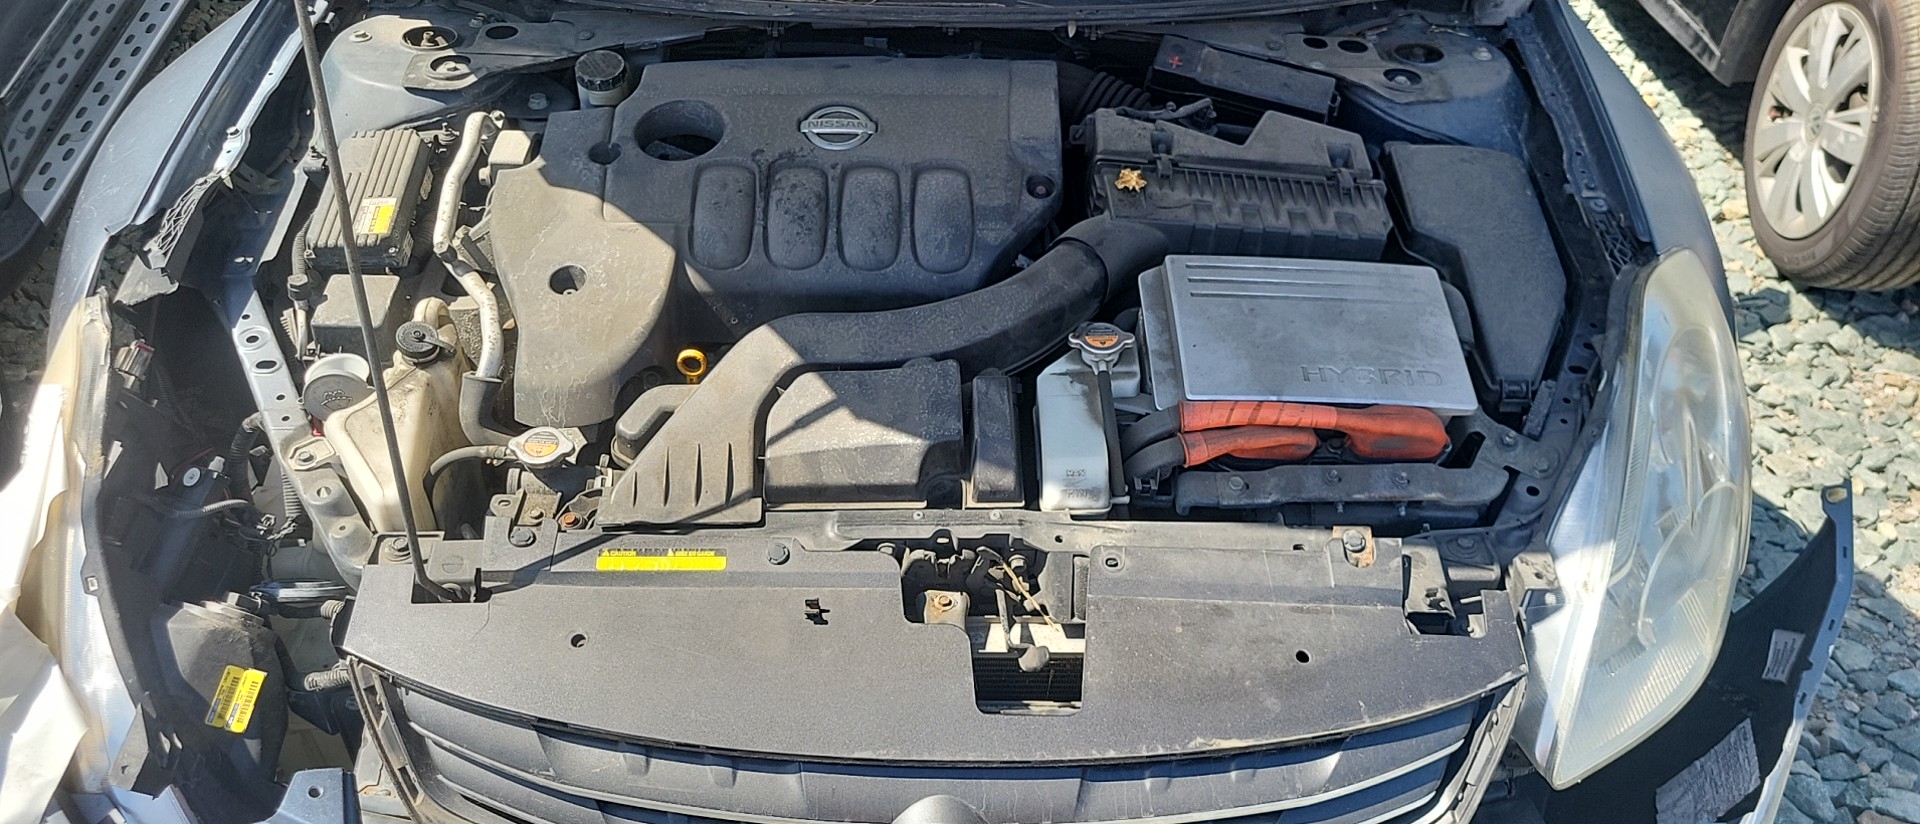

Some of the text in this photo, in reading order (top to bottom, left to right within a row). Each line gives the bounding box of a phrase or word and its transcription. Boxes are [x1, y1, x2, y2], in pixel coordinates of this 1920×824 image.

[807, 120, 868, 128] NISSAN
[1300, 365, 1443, 387] HYBRID
[1065, 469, 1086, 477] MAX
[1067, 488, 1088, 498] MIN
